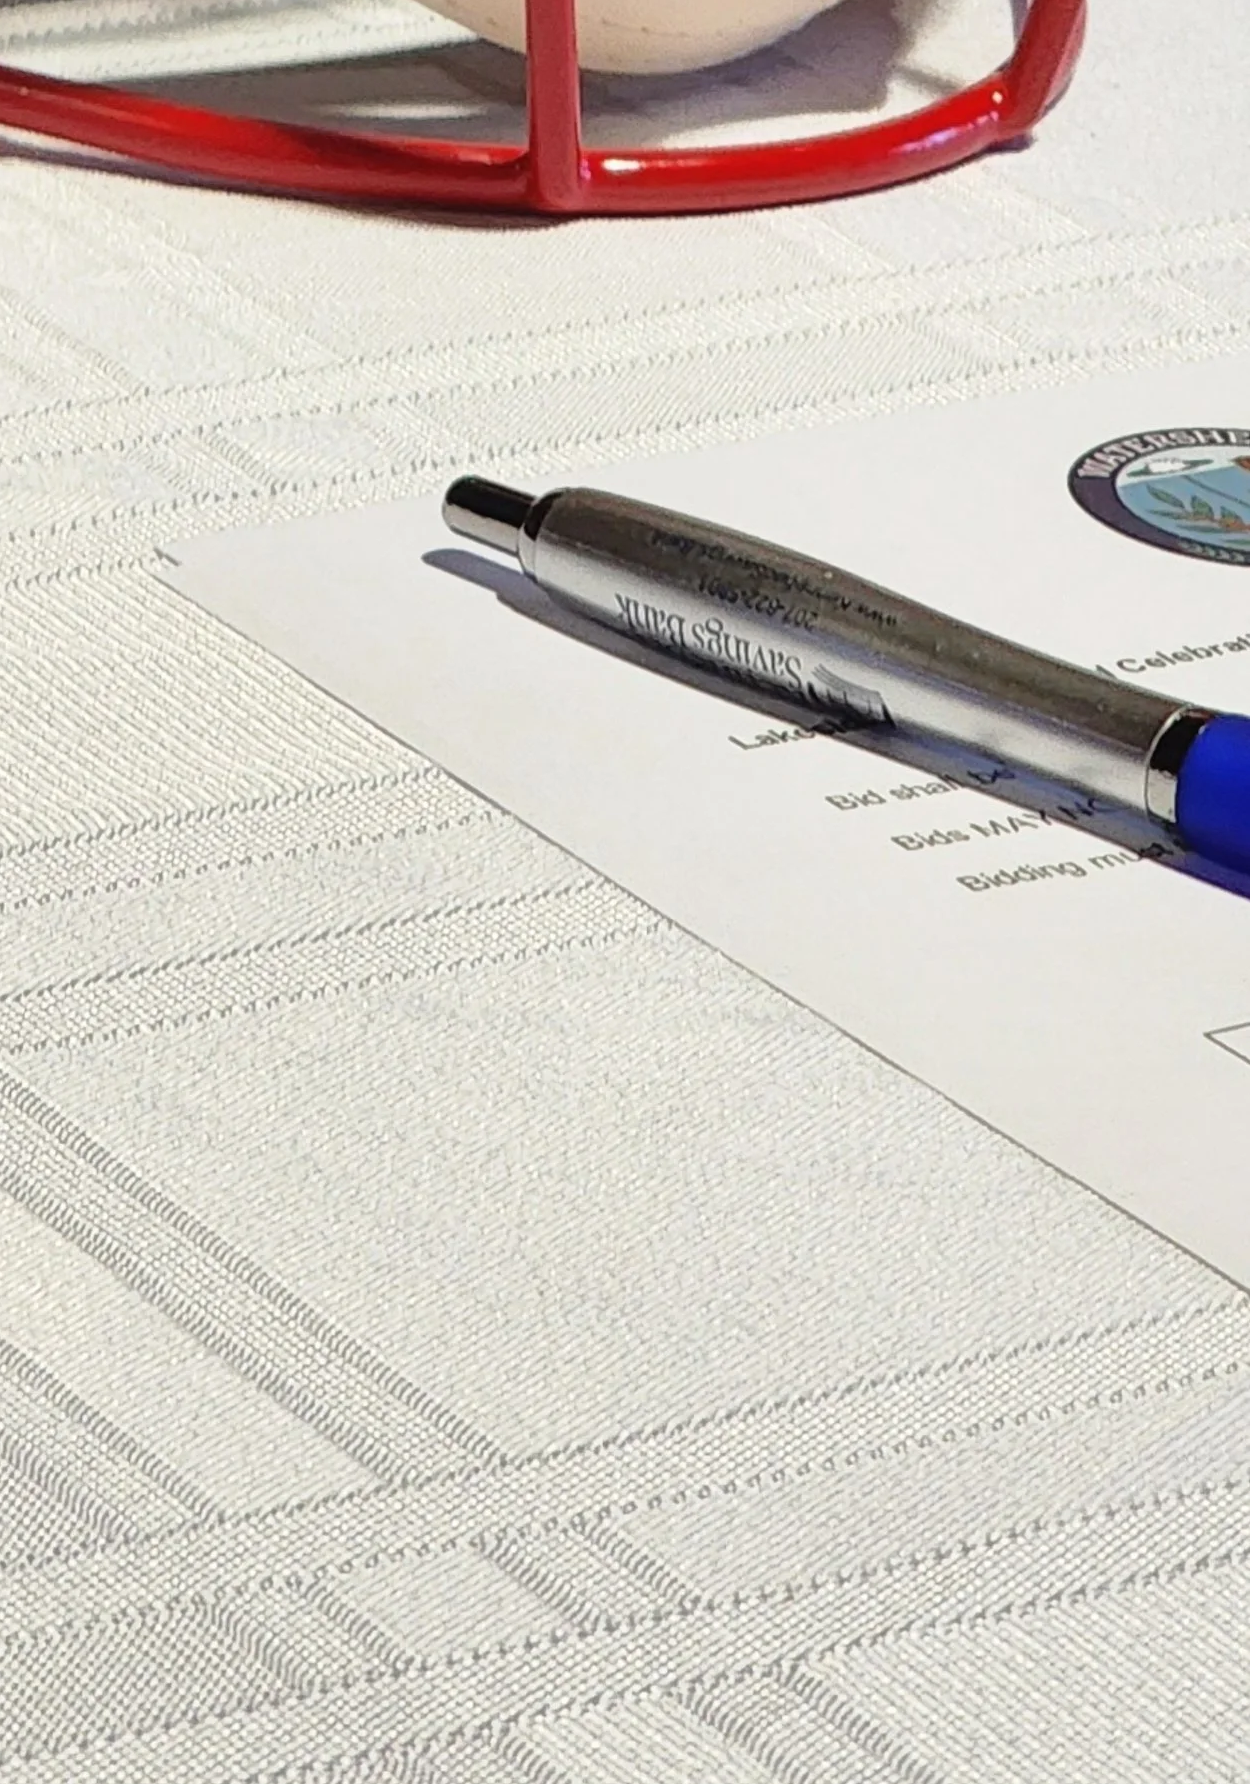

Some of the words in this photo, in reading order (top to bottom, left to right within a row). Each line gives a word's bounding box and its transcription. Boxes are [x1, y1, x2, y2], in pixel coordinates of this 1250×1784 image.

[614, 592, 686, 649] Bank
[690, 615, 802, 689] Savings
[824, 788, 887, 812] Bid
[890, 828, 971, 852] Bids
[955, 859, 1088, 893] Bidding
